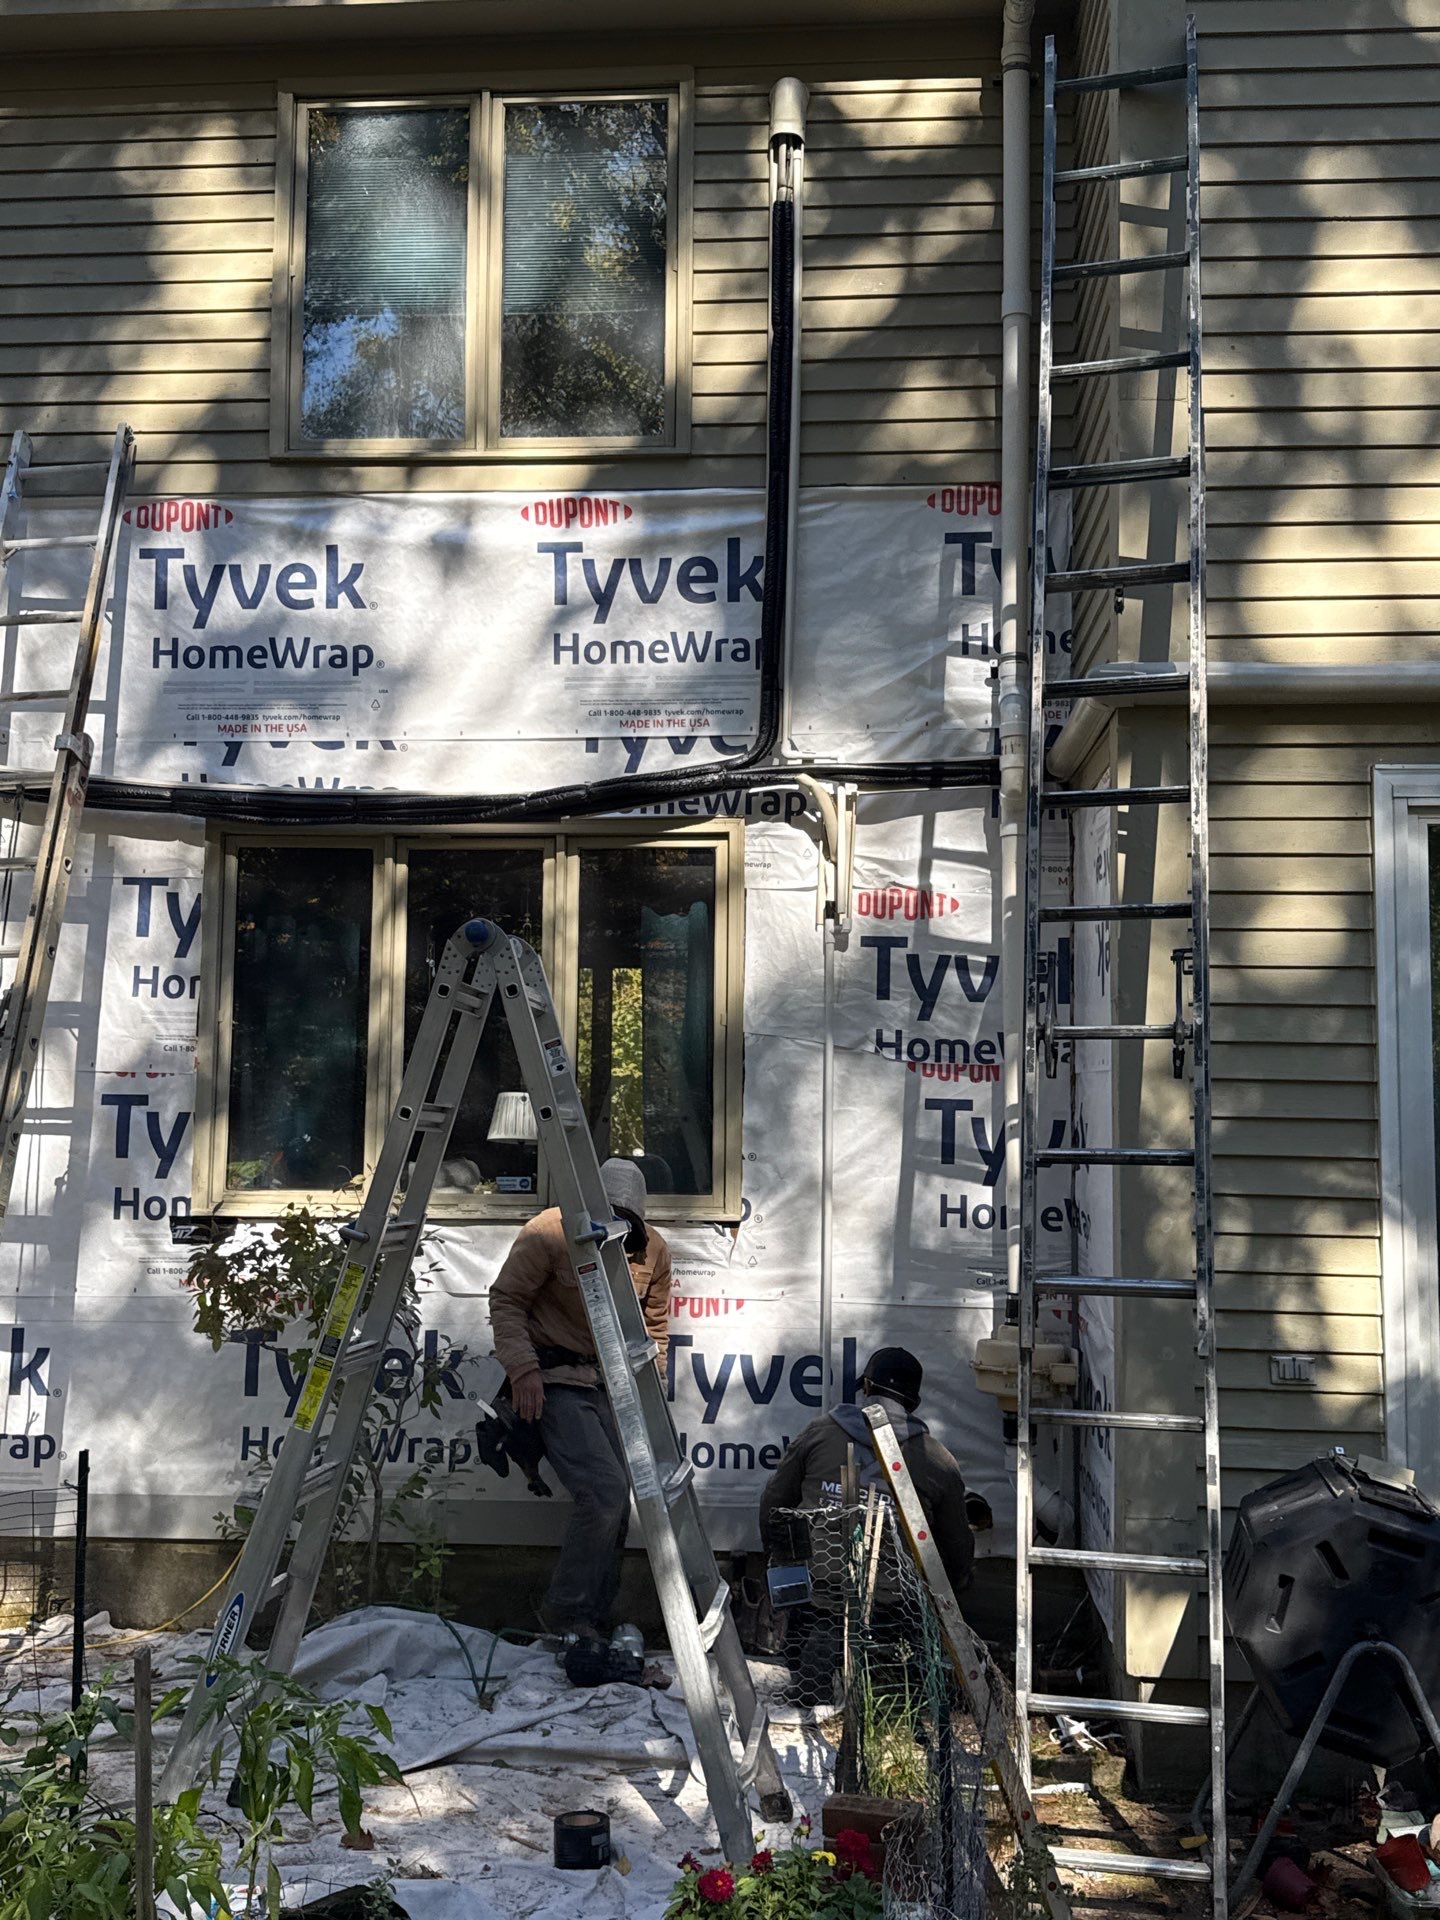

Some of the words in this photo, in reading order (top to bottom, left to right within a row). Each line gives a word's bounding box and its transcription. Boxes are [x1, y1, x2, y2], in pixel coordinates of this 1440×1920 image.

[136, 501, 222, 533] DUPONT
[535, 496, 620, 529] DUPONT
[537, 537, 764, 624] Tyvek
[186, 713, 200, 721] Call
[262, 713, 341, 723] tyvek.com/homewrap
[588, 708, 602, 717] Call
[664, 708, 745, 718] tyvek.com/homewrap
[217, 723, 248, 734] MADE
[250, 723, 262, 734] IN
[264, 723, 284, 734] THE
[286, 723, 308, 734] USA
[619, 719, 651, 729] MADE
[652, 719, 664, 729] IN
[666, 718, 687, 729] THE
[689, 718, 711, 728] USA
[858, 887, 945, 921] DUPONT
[163, 1045, 178, 1053] Call
[875, 1029, 1004, 1064] Home
[147, 1267, 161, 1275] Call
[976, 1278, 991, 1286] Call
[214, 1609, 239, 1661] ERNER
